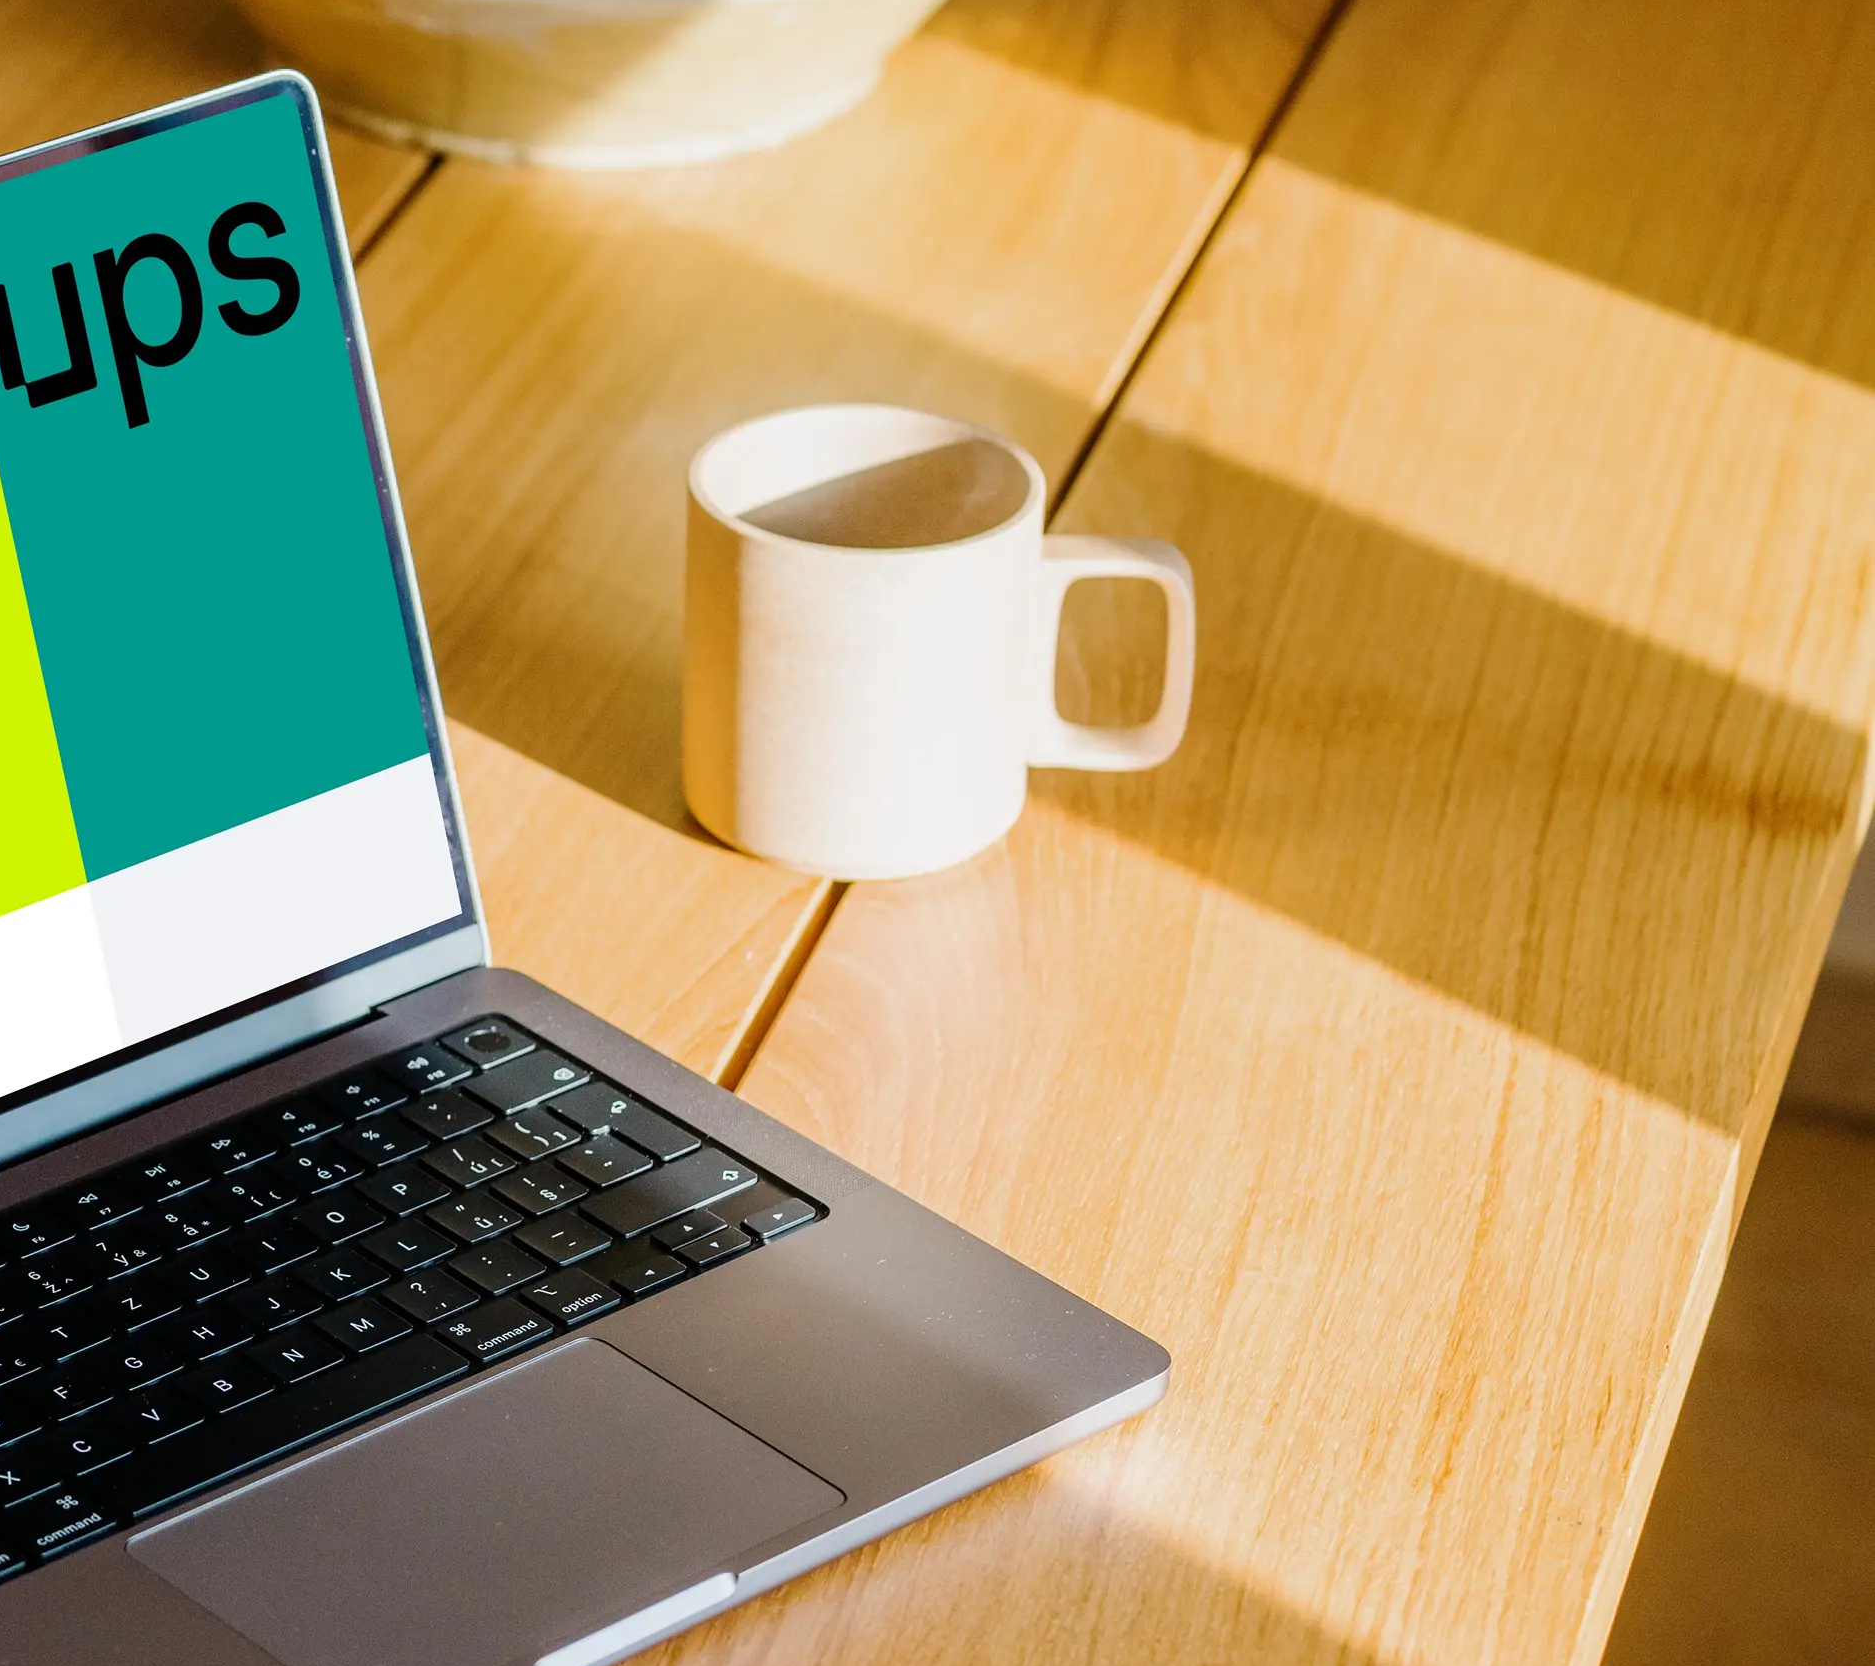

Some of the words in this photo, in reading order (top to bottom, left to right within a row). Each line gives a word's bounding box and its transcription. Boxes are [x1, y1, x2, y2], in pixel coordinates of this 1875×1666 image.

[297, 1123, 317, 1134] F10
[361, 1129, 381, 1141] %
[233, 1151, 247, 1161] F9
[298, 1157, 313, 1167] 0
[166, 1179, 182, 1188] F8
[391, 1183, 408, 1196] P
[231, 1185, 246, 1196] 9
[98, 1206, 112, 1216] F7
[325, 1211, 346, 1224] O
[164, 1213, 179, 1223] 8
[31, 1235, 46, 1244] F6
[261, 1240, 276, 1251] I
[95, 1241, 107, 1252] 7
[397, 1241, 418, 1252] L
[27, 1271, 42, 1281] 6
[189, 1267, 210, 1281] U
[329, 1267, 352, 1281] K
[121, 1297, 143, 1311] Z
[267, 1297, 281, 1310] J
[561, 1293, 603, 1314] option
[349, 1317, 375, 1333] M
[50, 1326, 68, 1339] T
[191, 1326, 215, 1340] H
[477, 1319, 539, 1351] command
[281, 1348, 305, 1363] N
[124, 1356, 144, 1369] G
[52, 1385, 68, 1400] F
[212, 1379, 234, 1393] B
[140, 1408, 161, 1422] V
[72, 1440, 92, 1453] C
[36, 1512, 102, 1546] command
